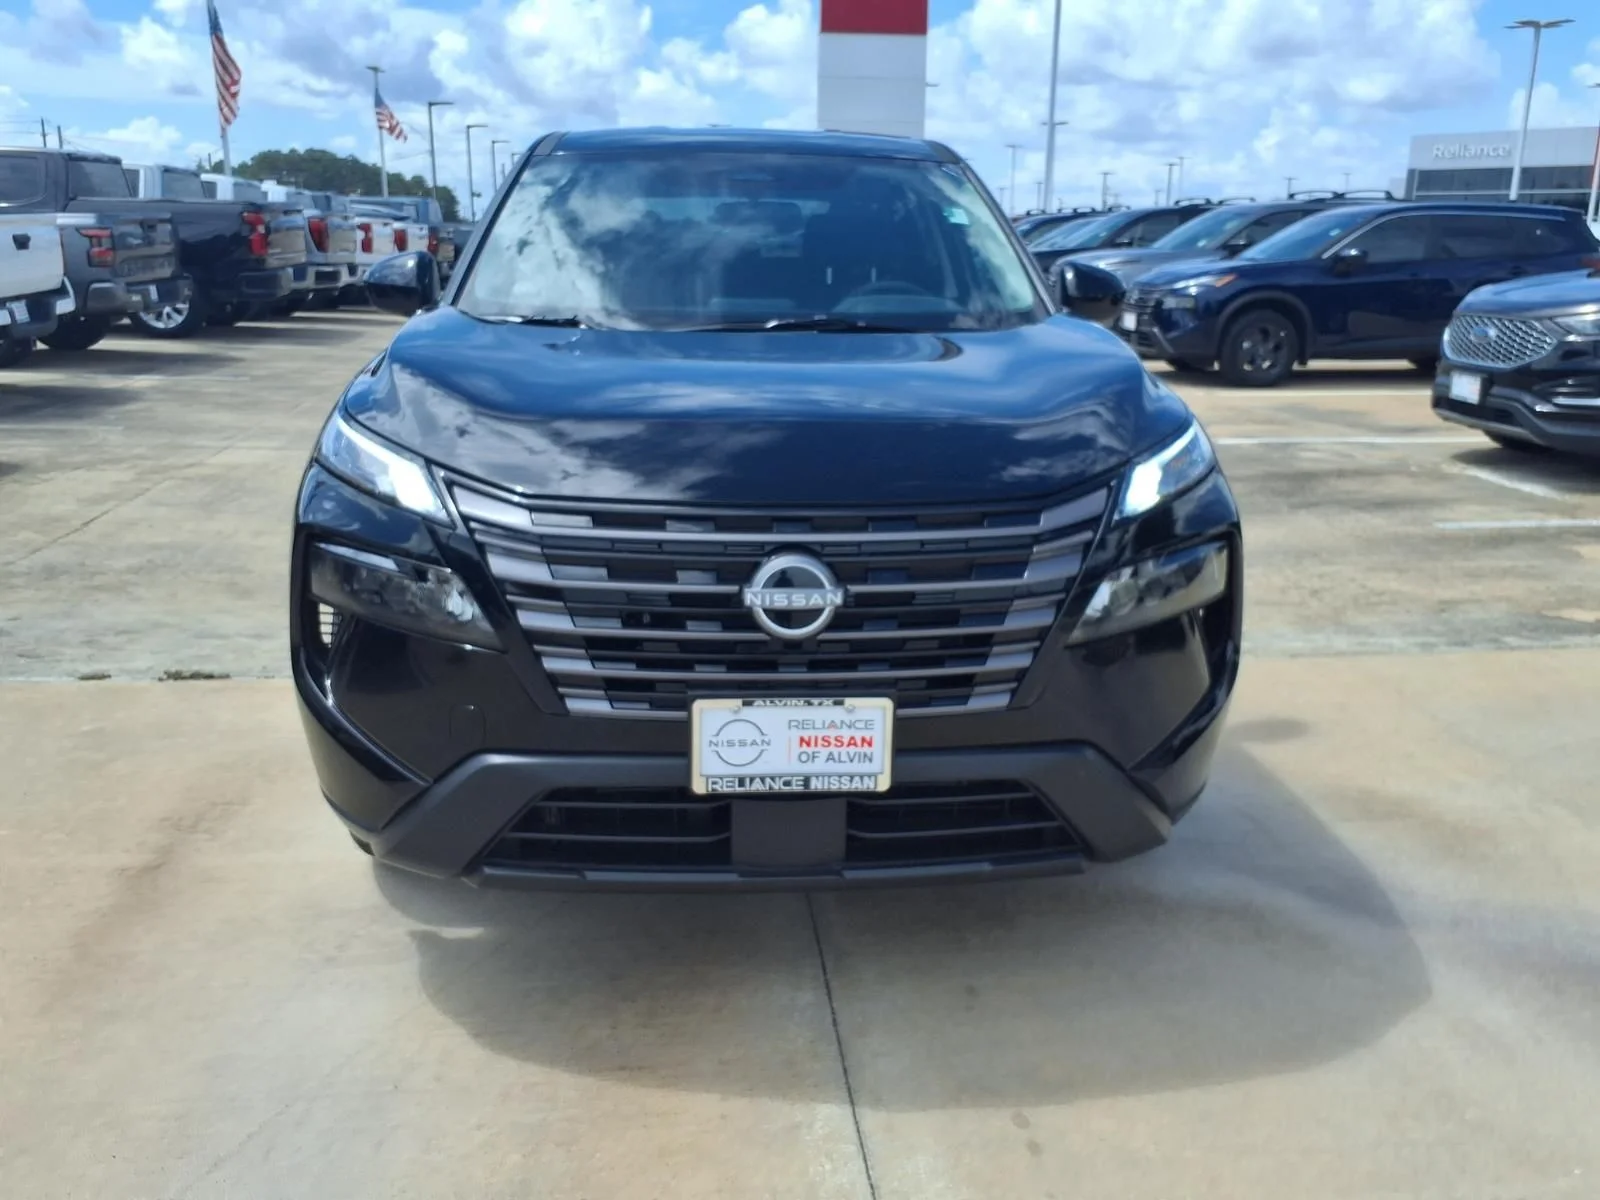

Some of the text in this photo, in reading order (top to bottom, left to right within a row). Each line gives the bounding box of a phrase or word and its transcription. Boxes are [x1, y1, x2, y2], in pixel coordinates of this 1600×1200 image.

[1432, 143, 1510, 159] Reliance
[746, 591, 842, 606] NISSAN
[788, 719, 875, 730] RELIANCE
[709, 739, 771, 747] NISSAN
[799, 735, 873, 748] NISSAN
[798, 751, 873, 764] OF ALVIN
[708, 775, 875, 792] RELIANCE NISSAN
